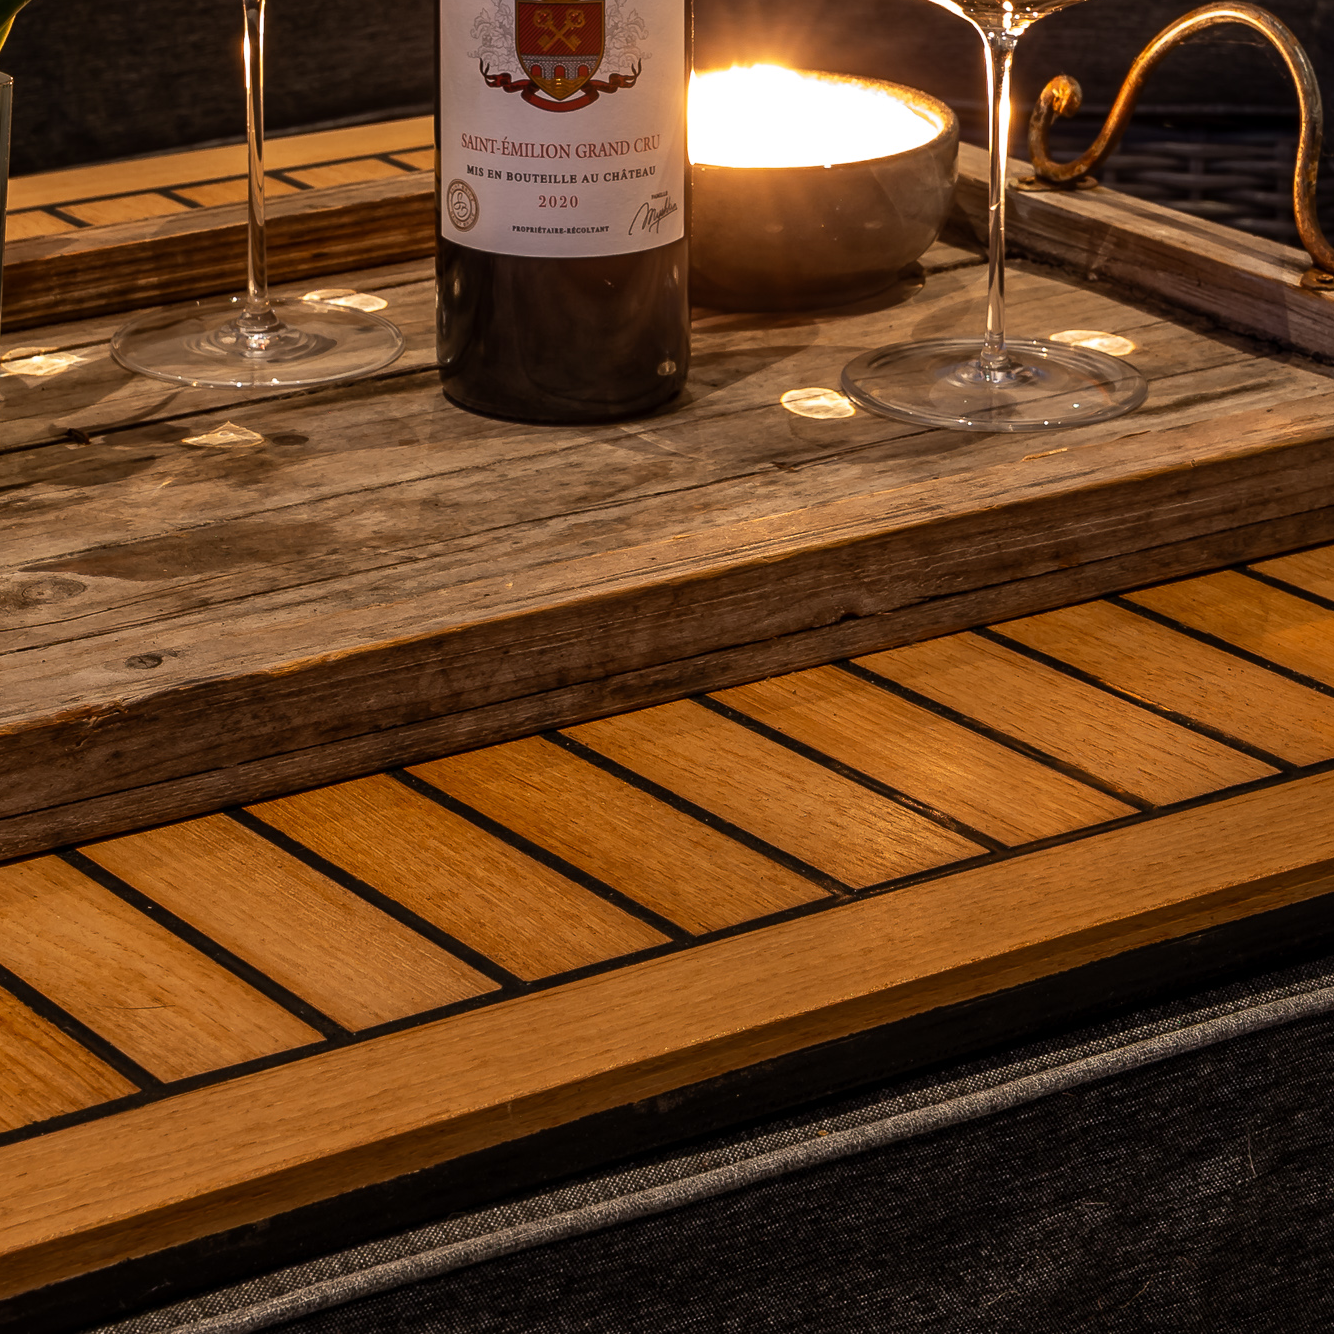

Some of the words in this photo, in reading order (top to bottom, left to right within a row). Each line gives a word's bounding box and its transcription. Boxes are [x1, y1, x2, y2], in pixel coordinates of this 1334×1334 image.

[461, 132, 571, 159] SAINT-ÉMILION
[575, 139, 630, 159] GRAND
[633, 133, 661, 153] CRU
[466, 165, 484, 177] MIS
[487, 169, 502, 180] EN
[506, 171, 578, 184] BOUTEILLE
[581, 173, 599, 184] AU
[603, 165, 656, 182] CHÂTEAU
[538, 194, 579, 208] 2020
[512, 225, 610, 235] PROPRIÉTAIRE-RÉCOLTANT
